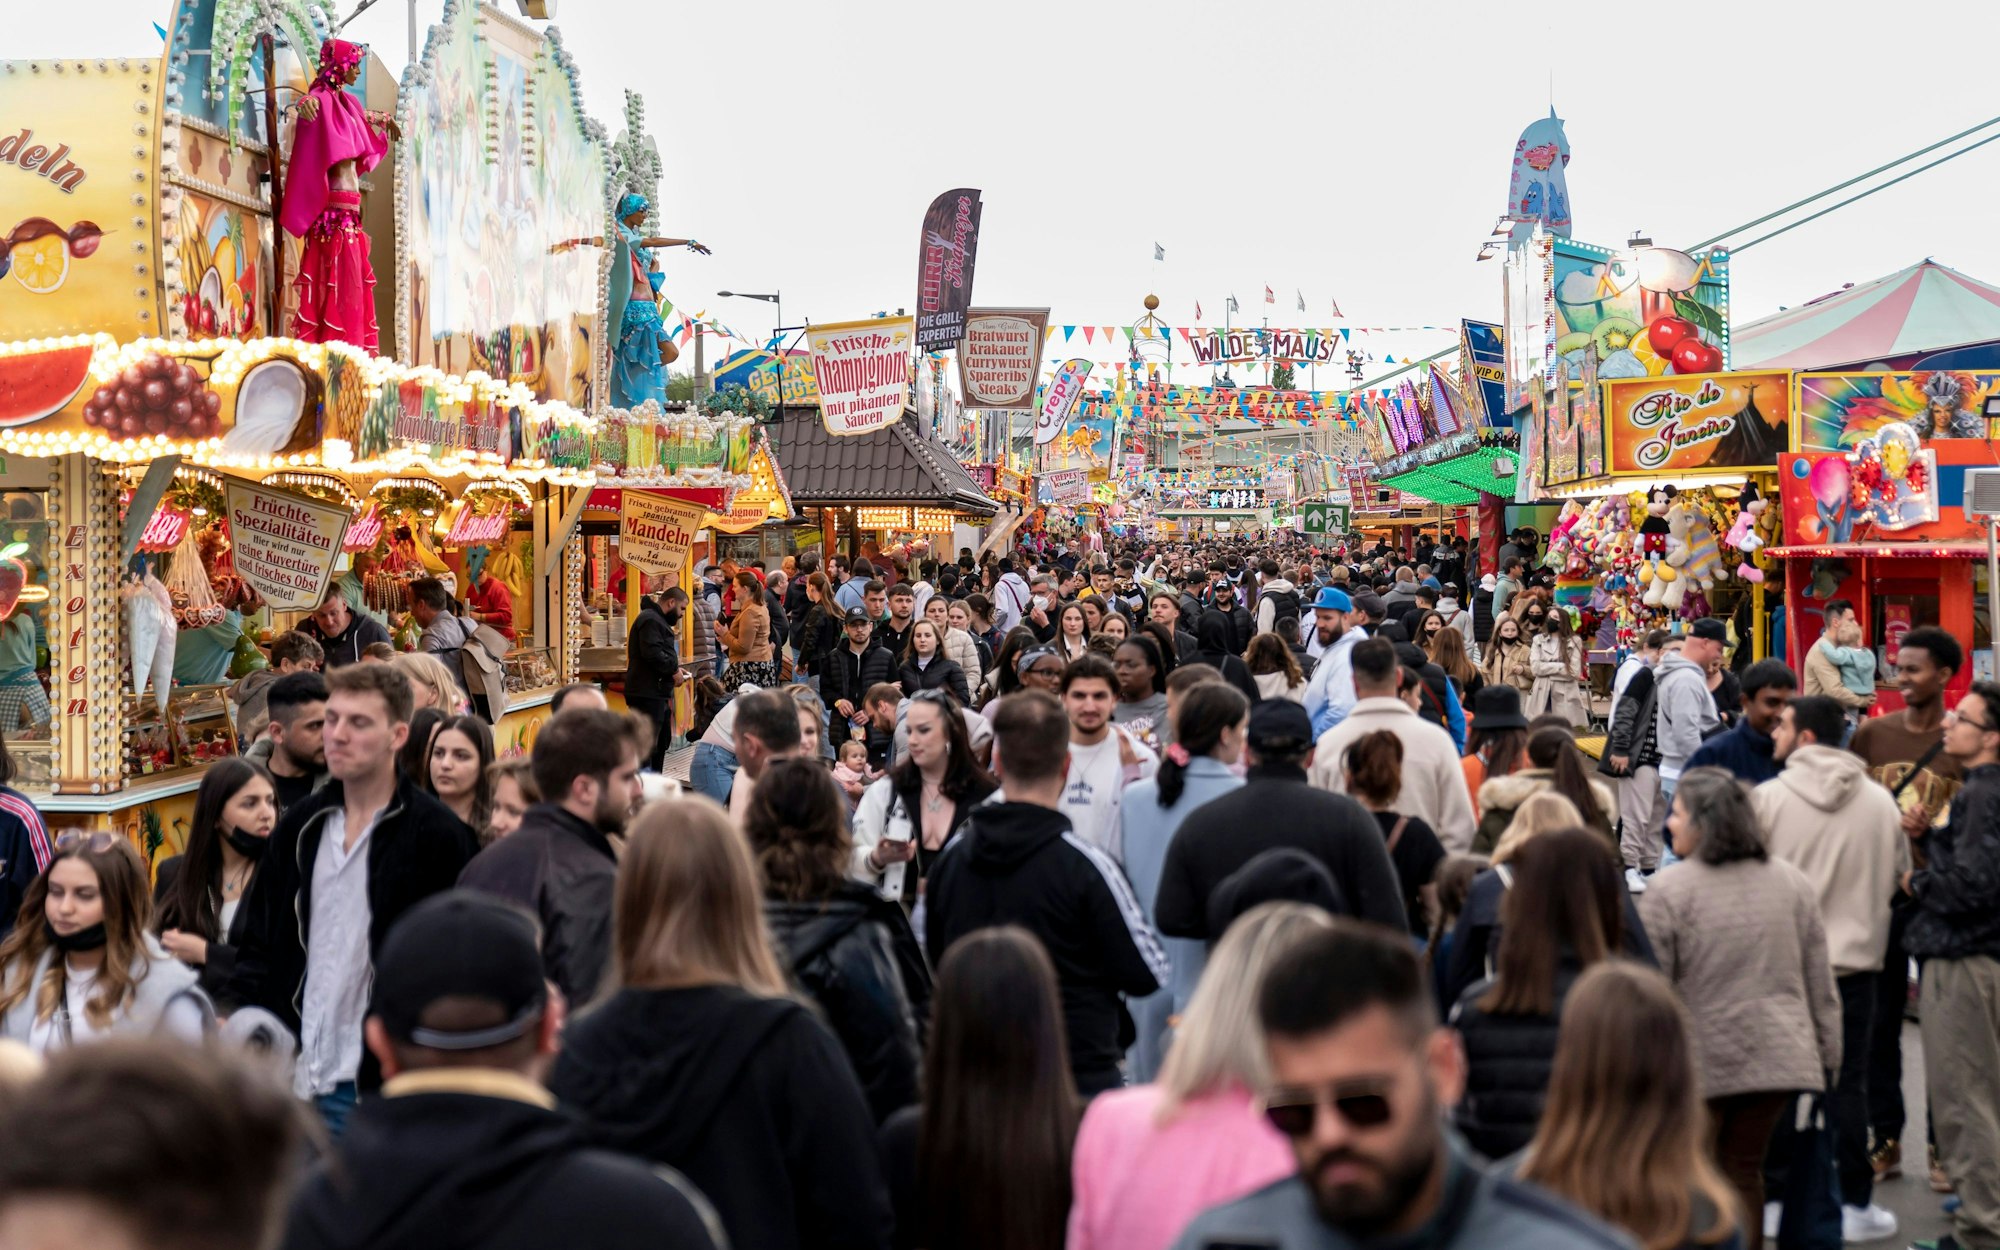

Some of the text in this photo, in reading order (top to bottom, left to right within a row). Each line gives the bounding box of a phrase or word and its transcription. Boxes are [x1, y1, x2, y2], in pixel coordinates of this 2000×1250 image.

[944, 196, 974, 288] Krameyer
[920, 311, 963, 328] DIE GRILL-
[831, 333, 891, 355] Frische
[918, 325, 962, 342] EXPERTEN
[969, 330, 1029, 342] Bratwurst
[969, 344, 1028, 355] Krakauer
[1195, 334, 1334, 361] WILDE MAUS
[815, 350, 908, 396] Champignons
[966, 357, 1031, 369] Currywurst
[1476, 366, 1491, 377] VIP
[969, 370, 1027, 382] Spareribs
[978, 384, 1018, 395] Steaks
[826, 393, 900, 416] mit pikanten
[1633, 383, 1720, 425] Rio de
[394, 404, 500, 450] Kandierte Früchte
[845, 411, 883, 428] Saucen
[1638, 420, 1731, 466] Janeiro
[1050, 472, 1078, 482] CREPES
[253, 495, 317, 523] Früchte-
[628, 498, 697, 519] Frisch gebrannte
[643, 511, 679, 524] spanische
[234, 509, 330, 548] Spezialitäten
[624, 517, 690, 546] Mandeln
[253, 535, 306, 556] Hier wird nur
[624, 536, 686, 554] mit wenig Zucker
[238, 542, 320, 575] reine Kuvertüre
[627, 552, 677, 569] Spitzenqualität
[238, 557, 318, 592] und frisches Obst
[253, 579, 295, 601] verarbeitet!
[65, 525, 88, 715] Exoten
